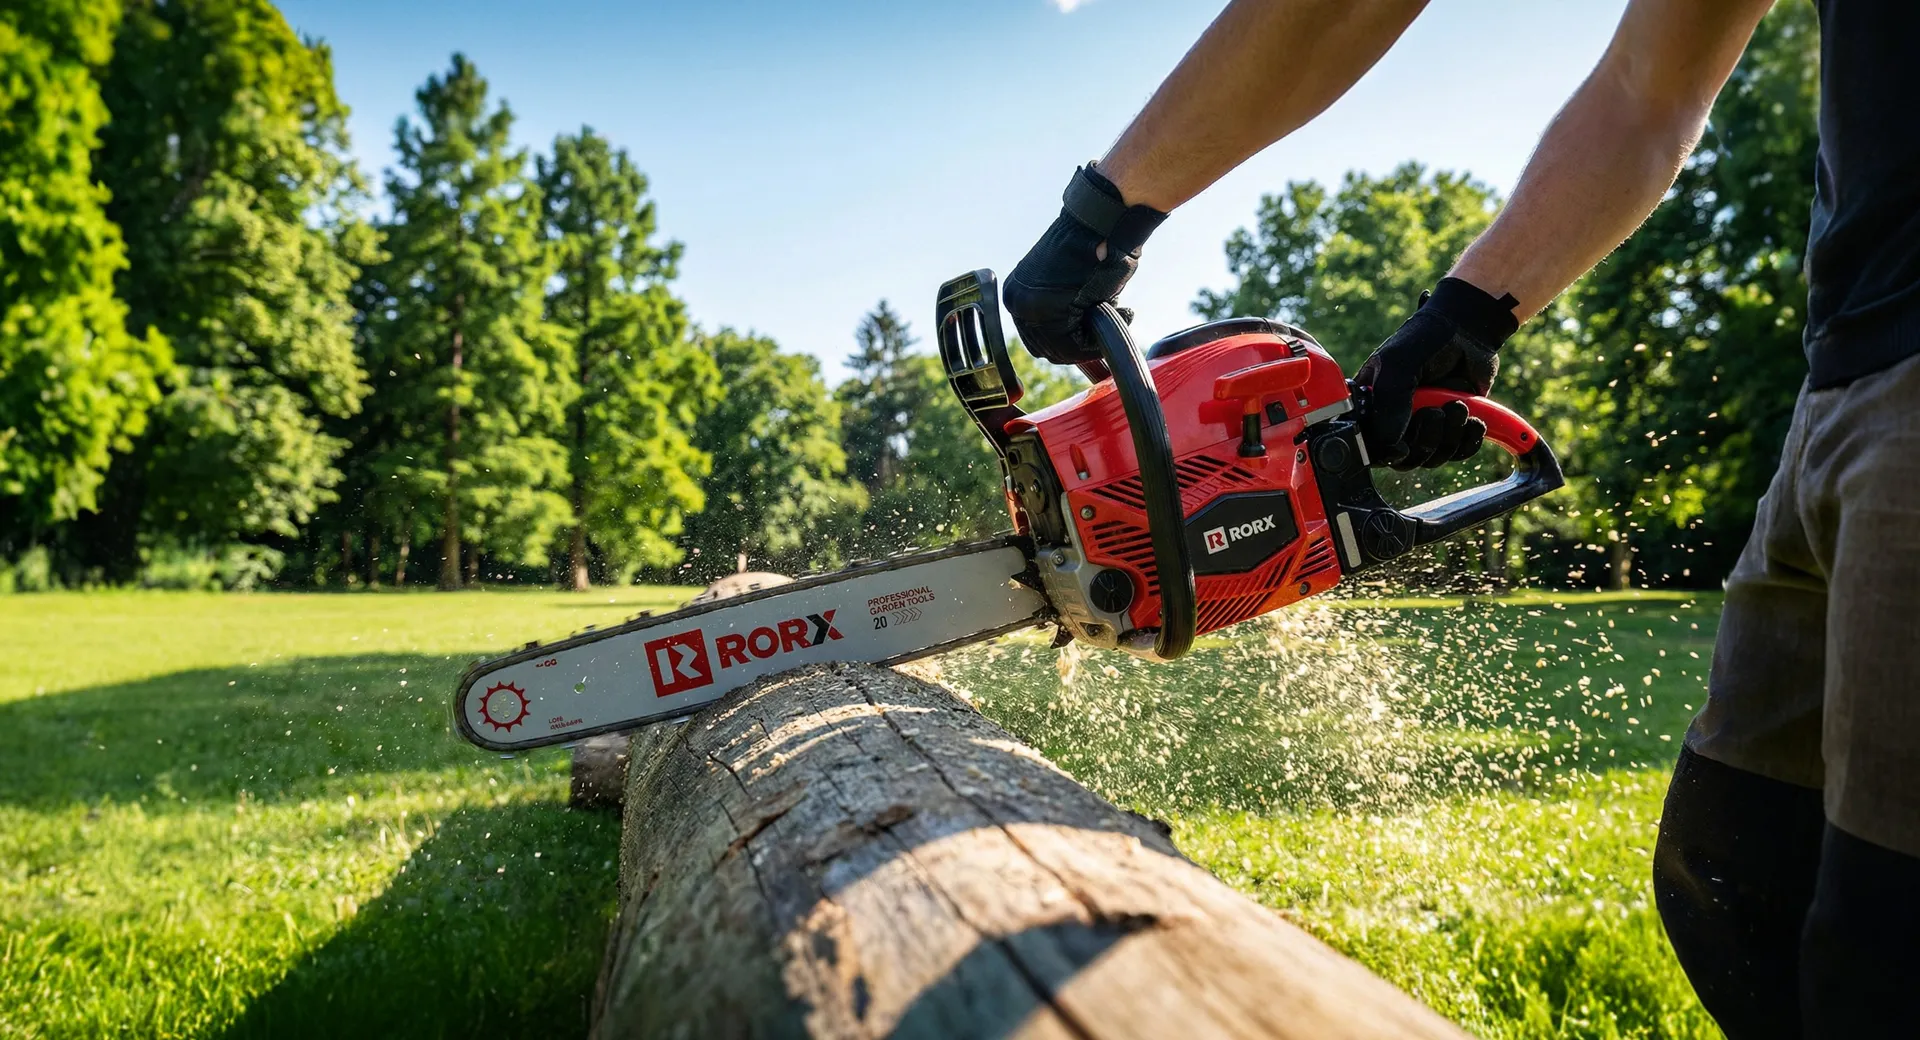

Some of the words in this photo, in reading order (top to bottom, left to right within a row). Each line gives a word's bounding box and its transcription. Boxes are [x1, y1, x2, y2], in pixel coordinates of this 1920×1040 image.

[1207, 531, 1225, 550] R
[1229, 514, 1276, 542] RORX
[868, 585, 932, 607] PROFESSIONAL
[869, 600, 906, 616] GARDEN
[906, 593, 935, 606] TOOLS
[873, 615, 888, 630] 20
[715, 609, 844, 669] RORX
